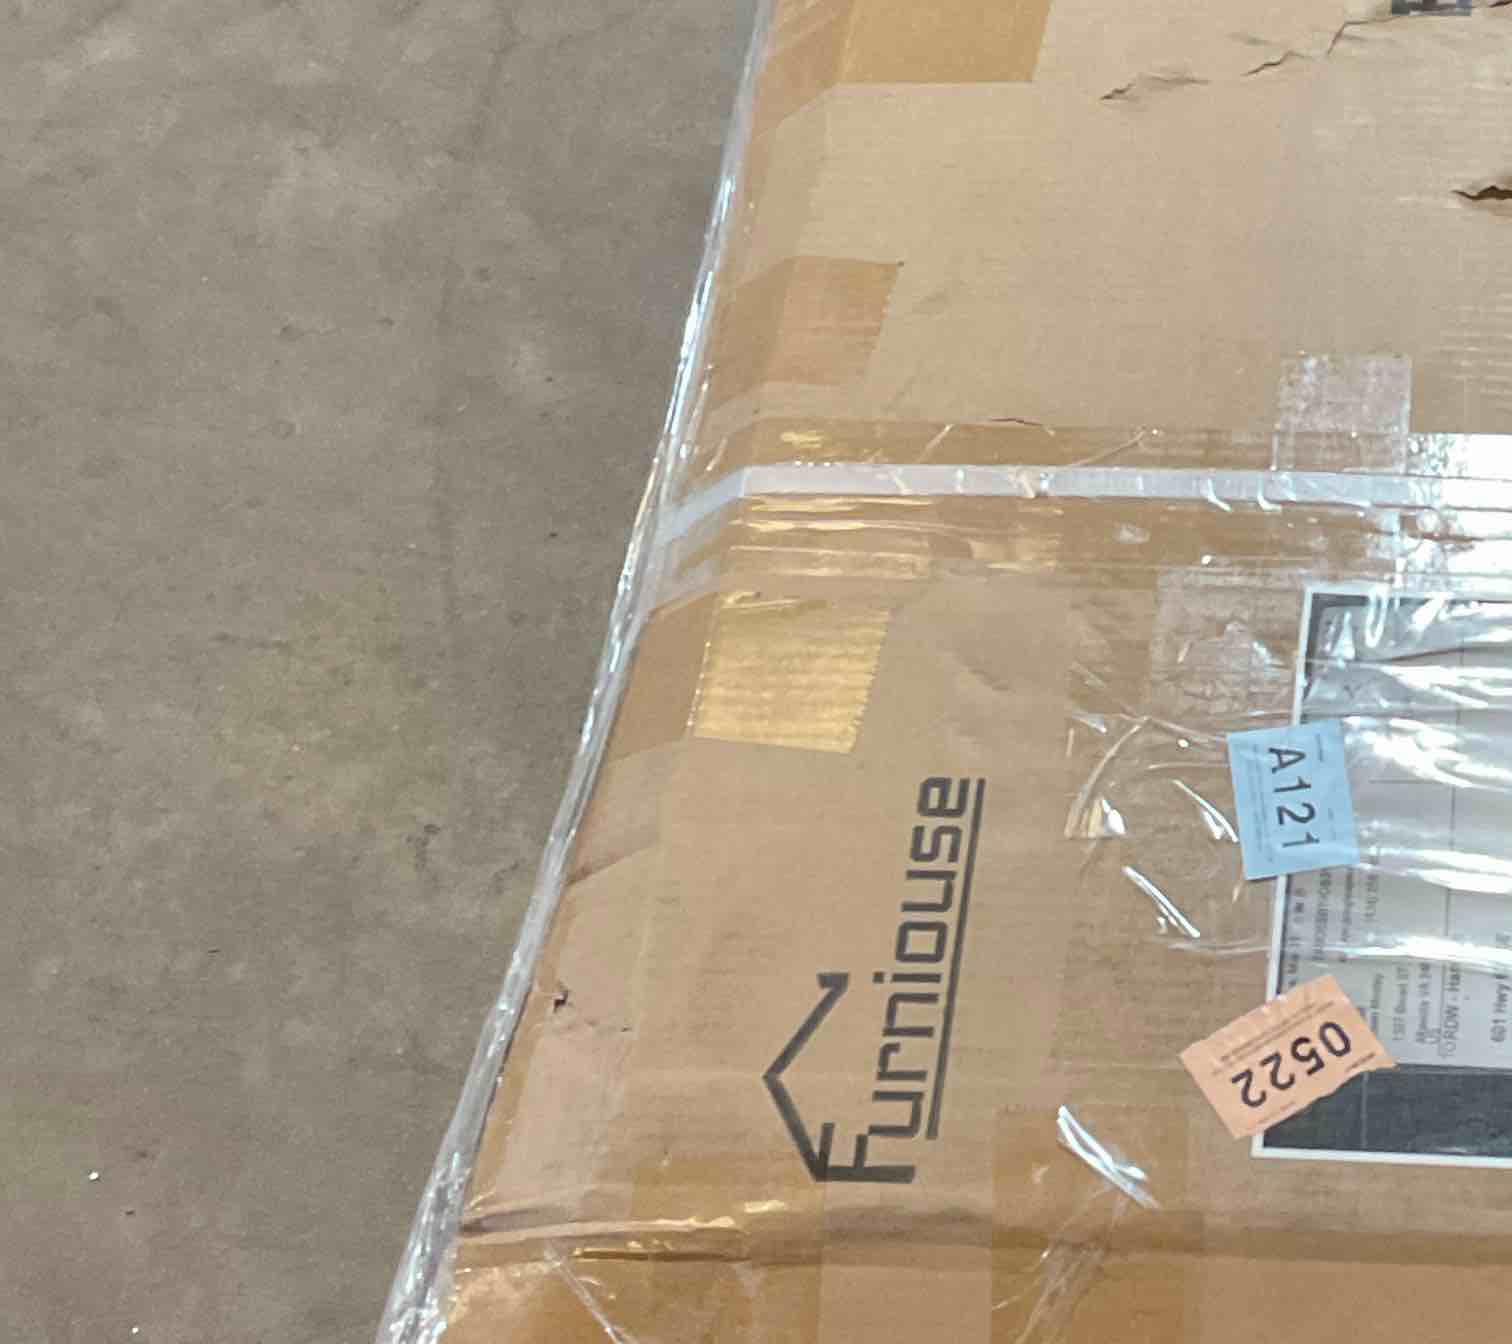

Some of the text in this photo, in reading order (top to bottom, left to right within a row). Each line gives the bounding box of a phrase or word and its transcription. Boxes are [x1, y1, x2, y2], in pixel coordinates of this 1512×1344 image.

[1268, 746, 1320, 848] A121
[812, 778, 971, 1184] Furniouse
[1231, 1022, 1352, 1109] 0522
